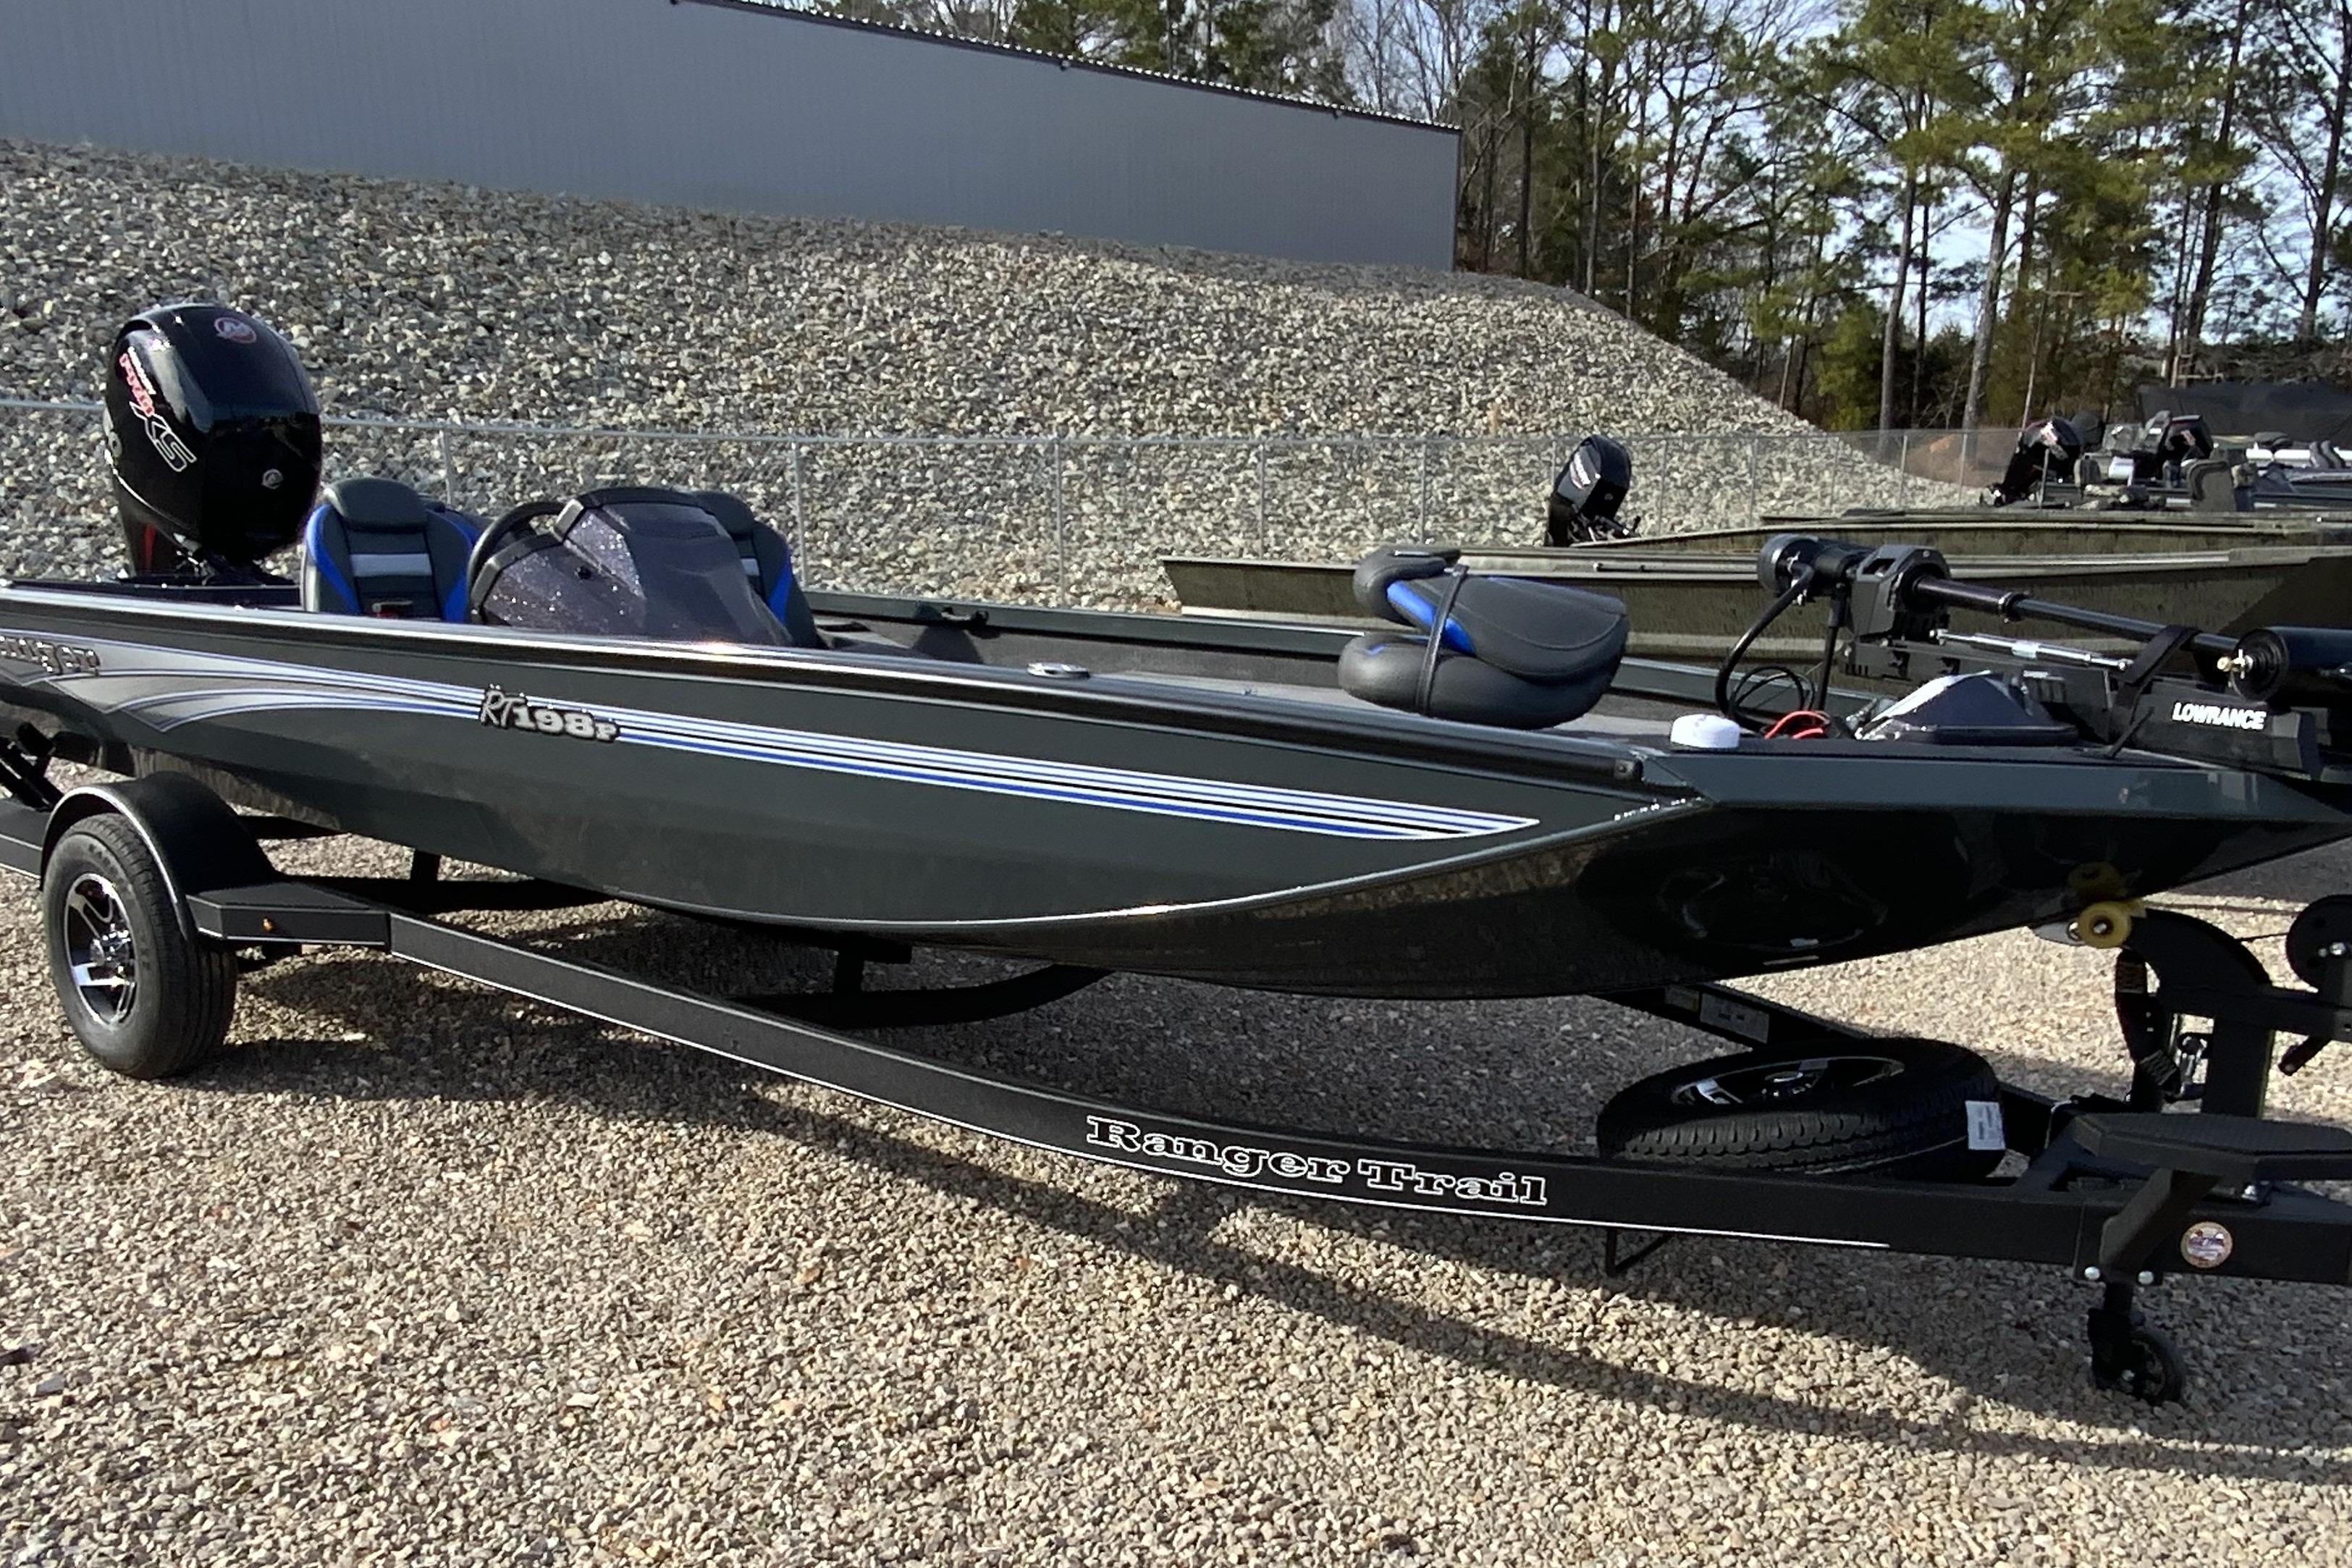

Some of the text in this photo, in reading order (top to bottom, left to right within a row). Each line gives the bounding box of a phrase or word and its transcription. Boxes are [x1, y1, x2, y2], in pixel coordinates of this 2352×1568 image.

[129, 400, 198, 472] XS
[2171, 701, 2267, 730] LOWRANCE
[1086, 1115, 1548, 1206] Ranger Trail
